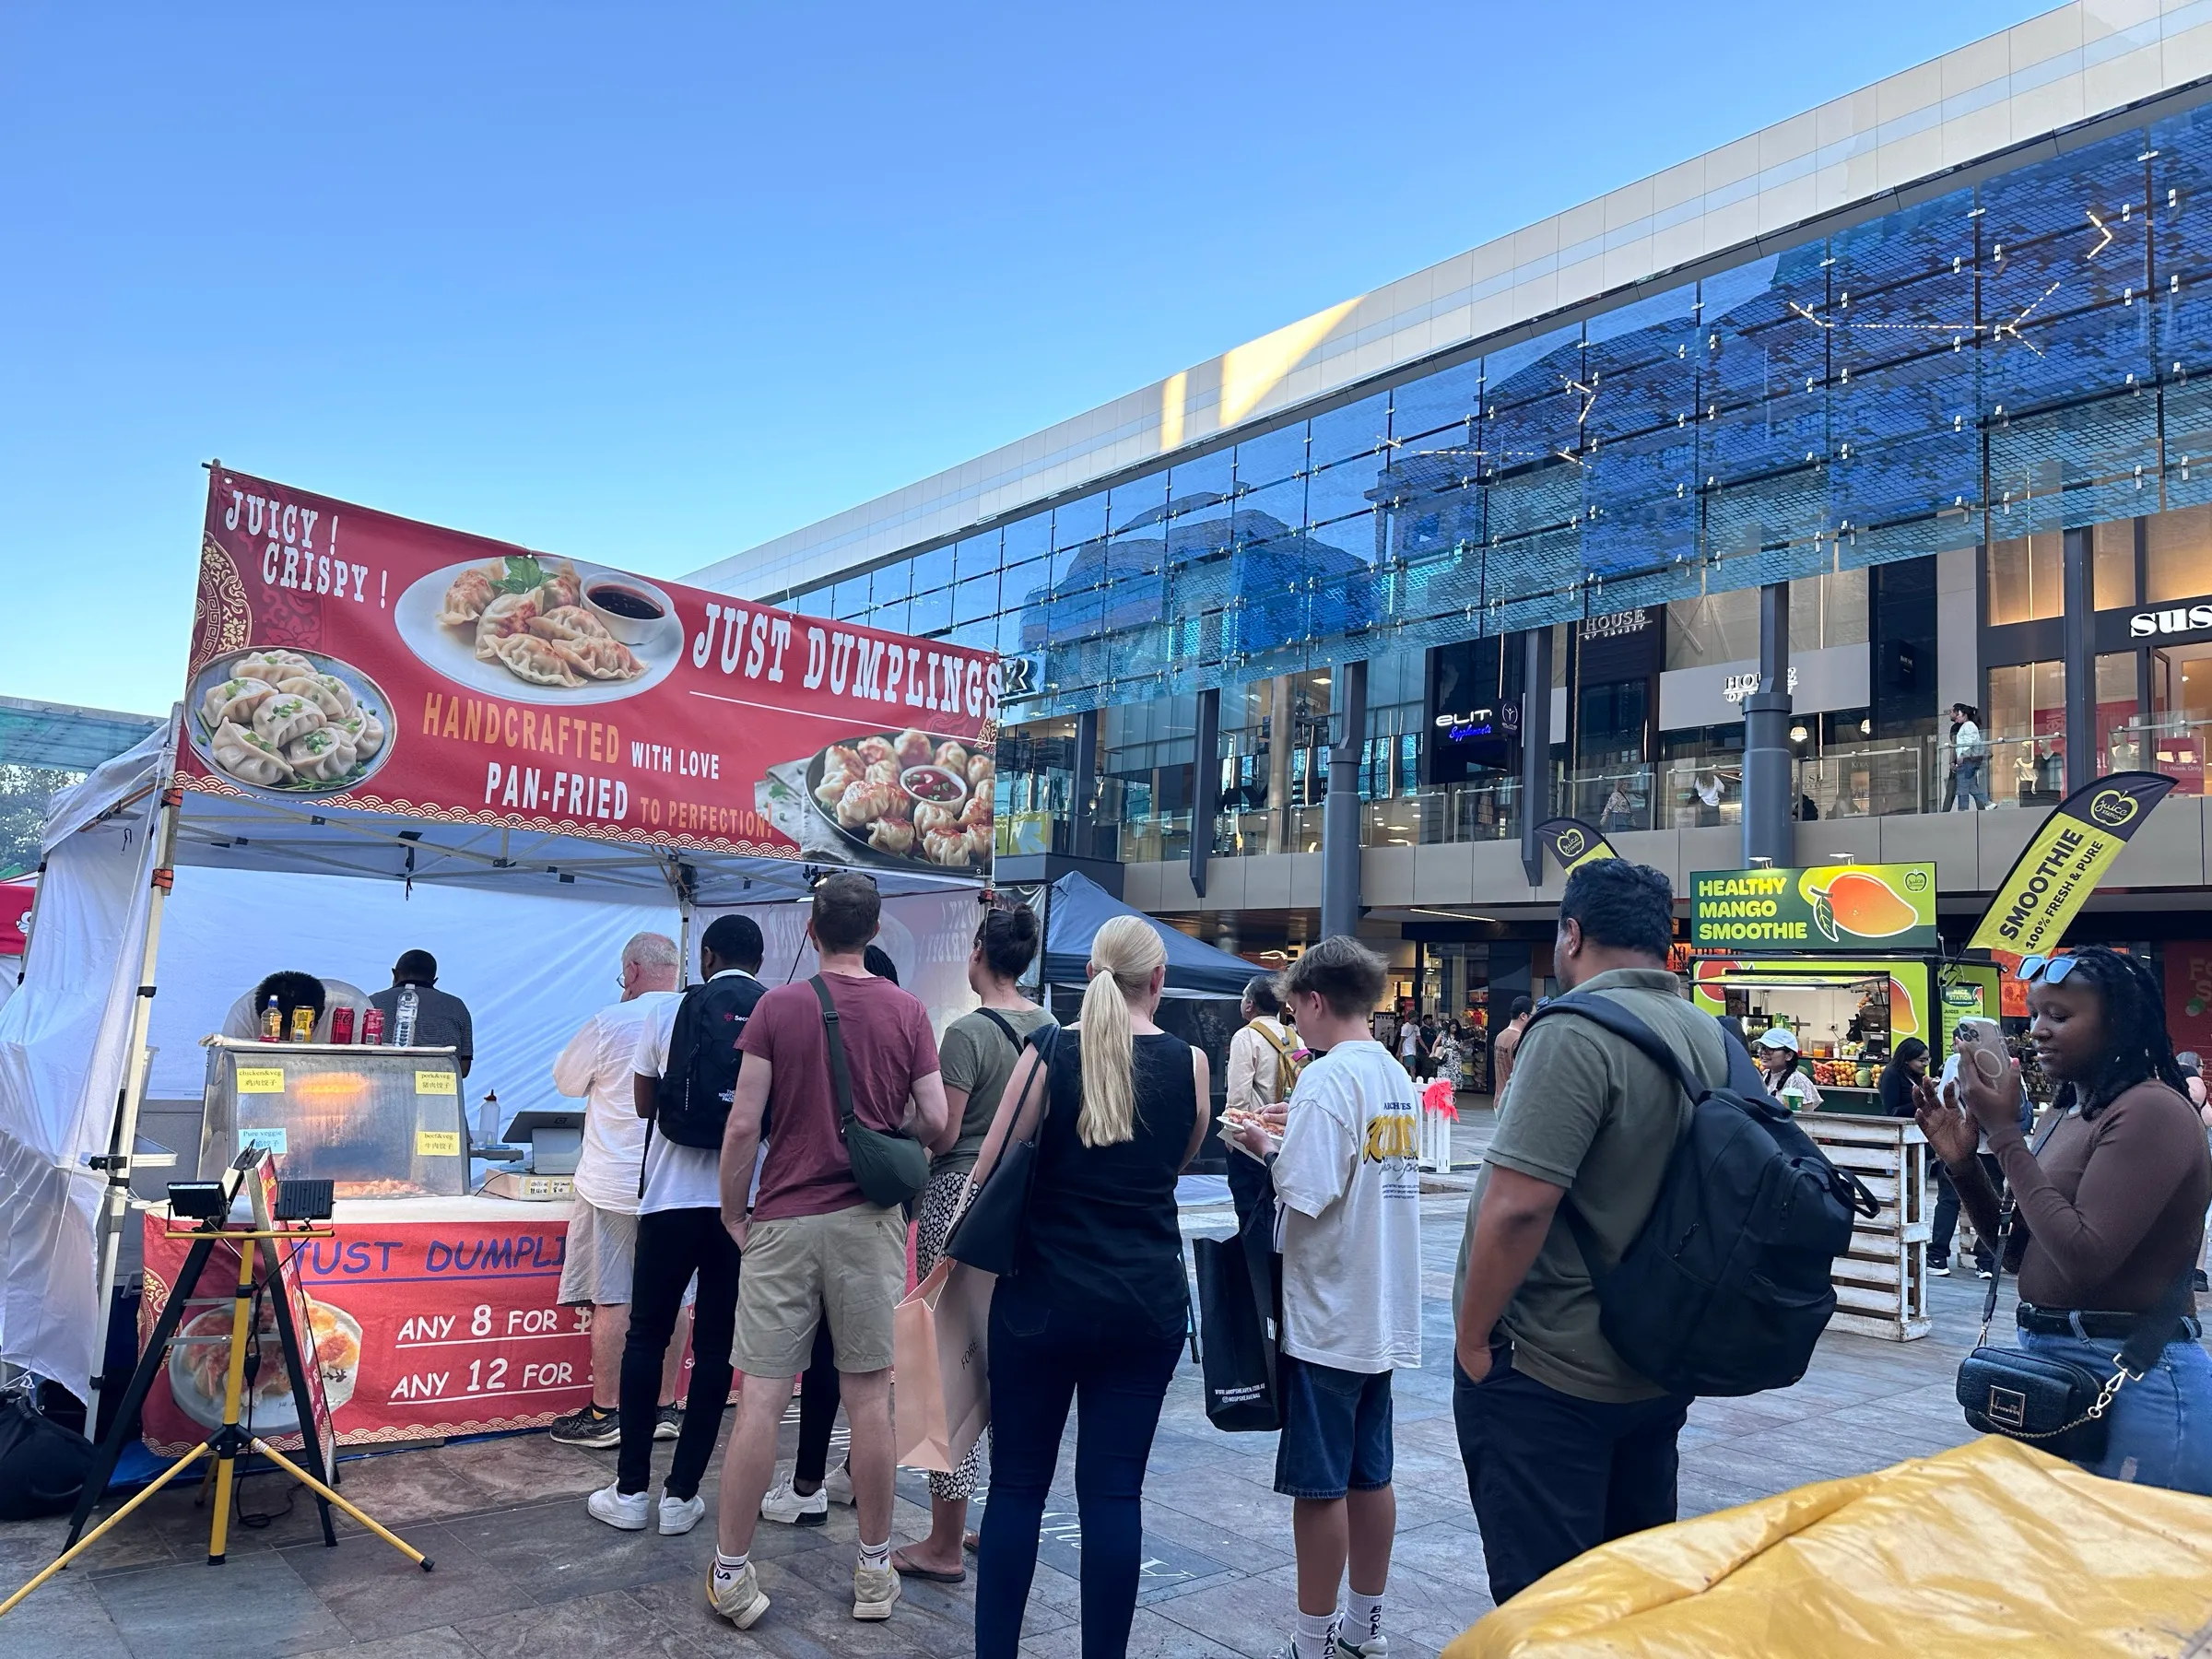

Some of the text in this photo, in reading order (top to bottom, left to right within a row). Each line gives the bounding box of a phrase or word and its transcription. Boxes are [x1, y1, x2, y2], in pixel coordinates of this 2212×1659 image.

[225, 490, 339, 555] JUICY !
[263, 542, 388, 608] CRISPY !
[1585, 609, 1645, 632] HOUSE
[693, 603, 999, 719] JUST DUMPLINGS
[423, 692, 720, 780] HANDCRAFTED WITH LOVE
[1436, 709, 1492, 726] ELIT
[485, 761, 773, 840] PAN-FRIED TO PERFECTION!
[1699, 877, 1787, 897] HEALTHY
[2000, 829, 2084, 941] SMOOTHIE
[2026, 841, 2103, 949] 100% FRESH & PURE
[1699, 900, 1777, 919] MANGO
[1699, 922, 1807, 940] SMOOTHIE
[292, 1241, 403, 1276] JUST
[426, 1236, 567, 1272] DUMPLI
[397, 1315, 456, 1341] ANY
[471, 1304, 493, 1336] 8
[508, 1310, 558, 1335] FOR
[391, 1371, 450, 1398] ANY
[467, 1358, 508, 1392] 12
[523, 1362, 572, 1387] FOR
[715, 1569, 731, 1580] ILA
